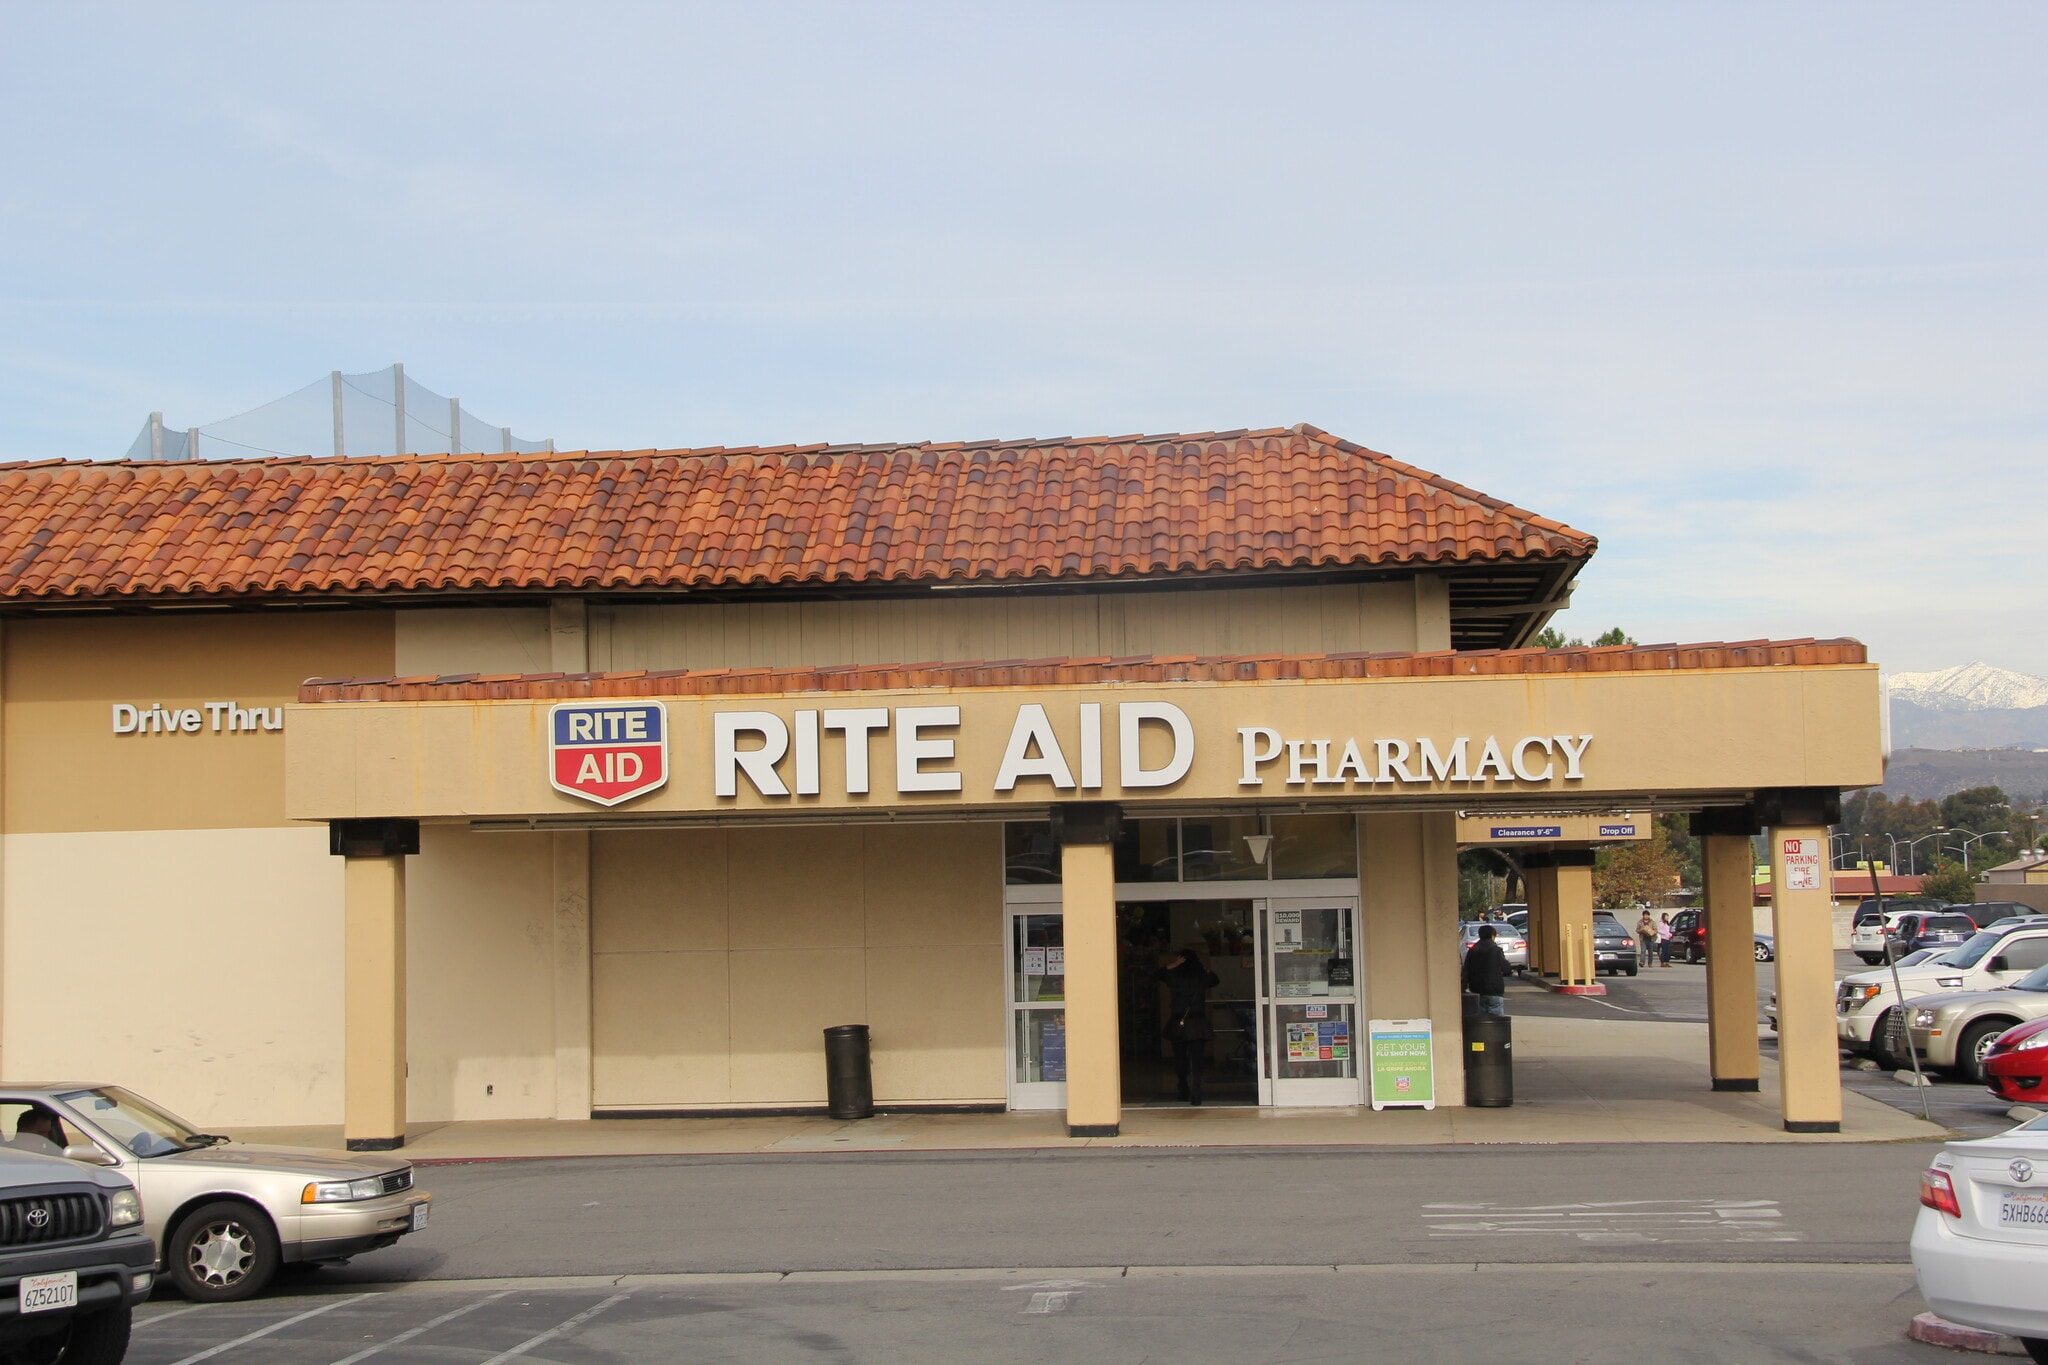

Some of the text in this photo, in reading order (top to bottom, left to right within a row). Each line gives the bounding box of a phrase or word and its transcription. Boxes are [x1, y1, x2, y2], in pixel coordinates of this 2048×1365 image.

[112, 701, 283, 733] Drive Thru
[569, 711, 647, 741] RITE
[713, 701, 1195, 797] RITE AID
[1237, 726, 1593, 785] PHARMACY
[575, 752, 644, 784] AID
[1498, 829, 1535, 837] Clearance
[1601, 827, 1620, 835] Drop
[1785, 841, 1799, 853] NO
[1785, 855, 1818, 864] PARKING
[1376, 1043, 1426, 1051] GET YOUR
[2011, 1192, 2045, 1203] California
[32, 1277, 66, 1287] California
[25, 1284, 74, 1307] 6Z52107
